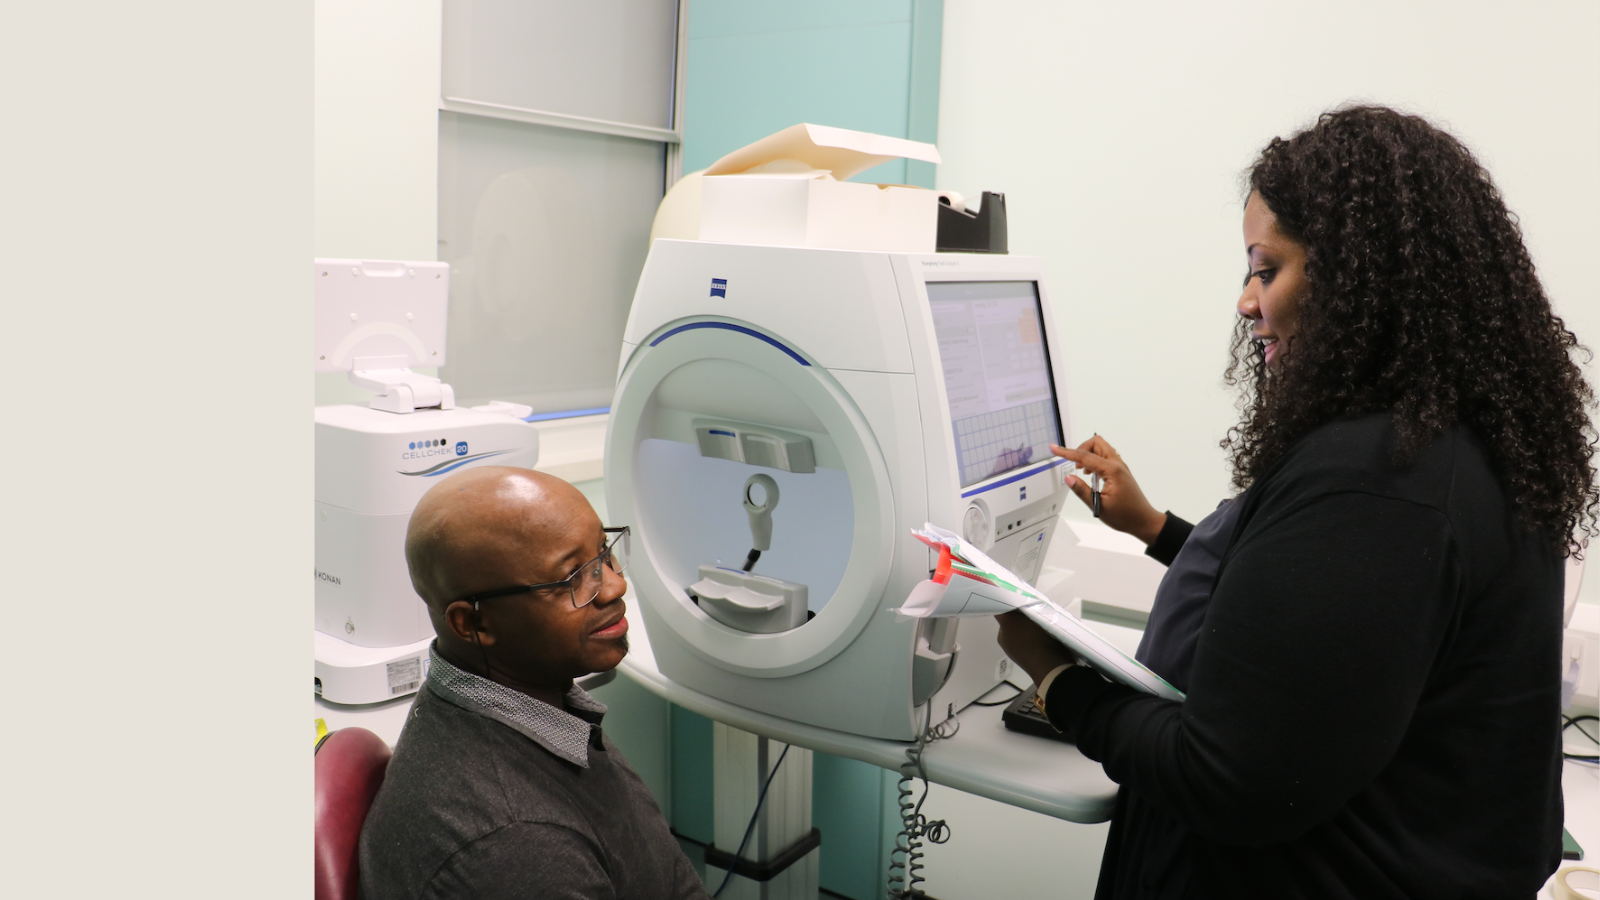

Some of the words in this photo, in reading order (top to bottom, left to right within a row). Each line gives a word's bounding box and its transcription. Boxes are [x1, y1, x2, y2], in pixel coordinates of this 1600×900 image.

[402, 448, 452, 459] CELLCHEK
[457, 445, 467, 453] 20
[318, 571, 341, 585] KONAN
